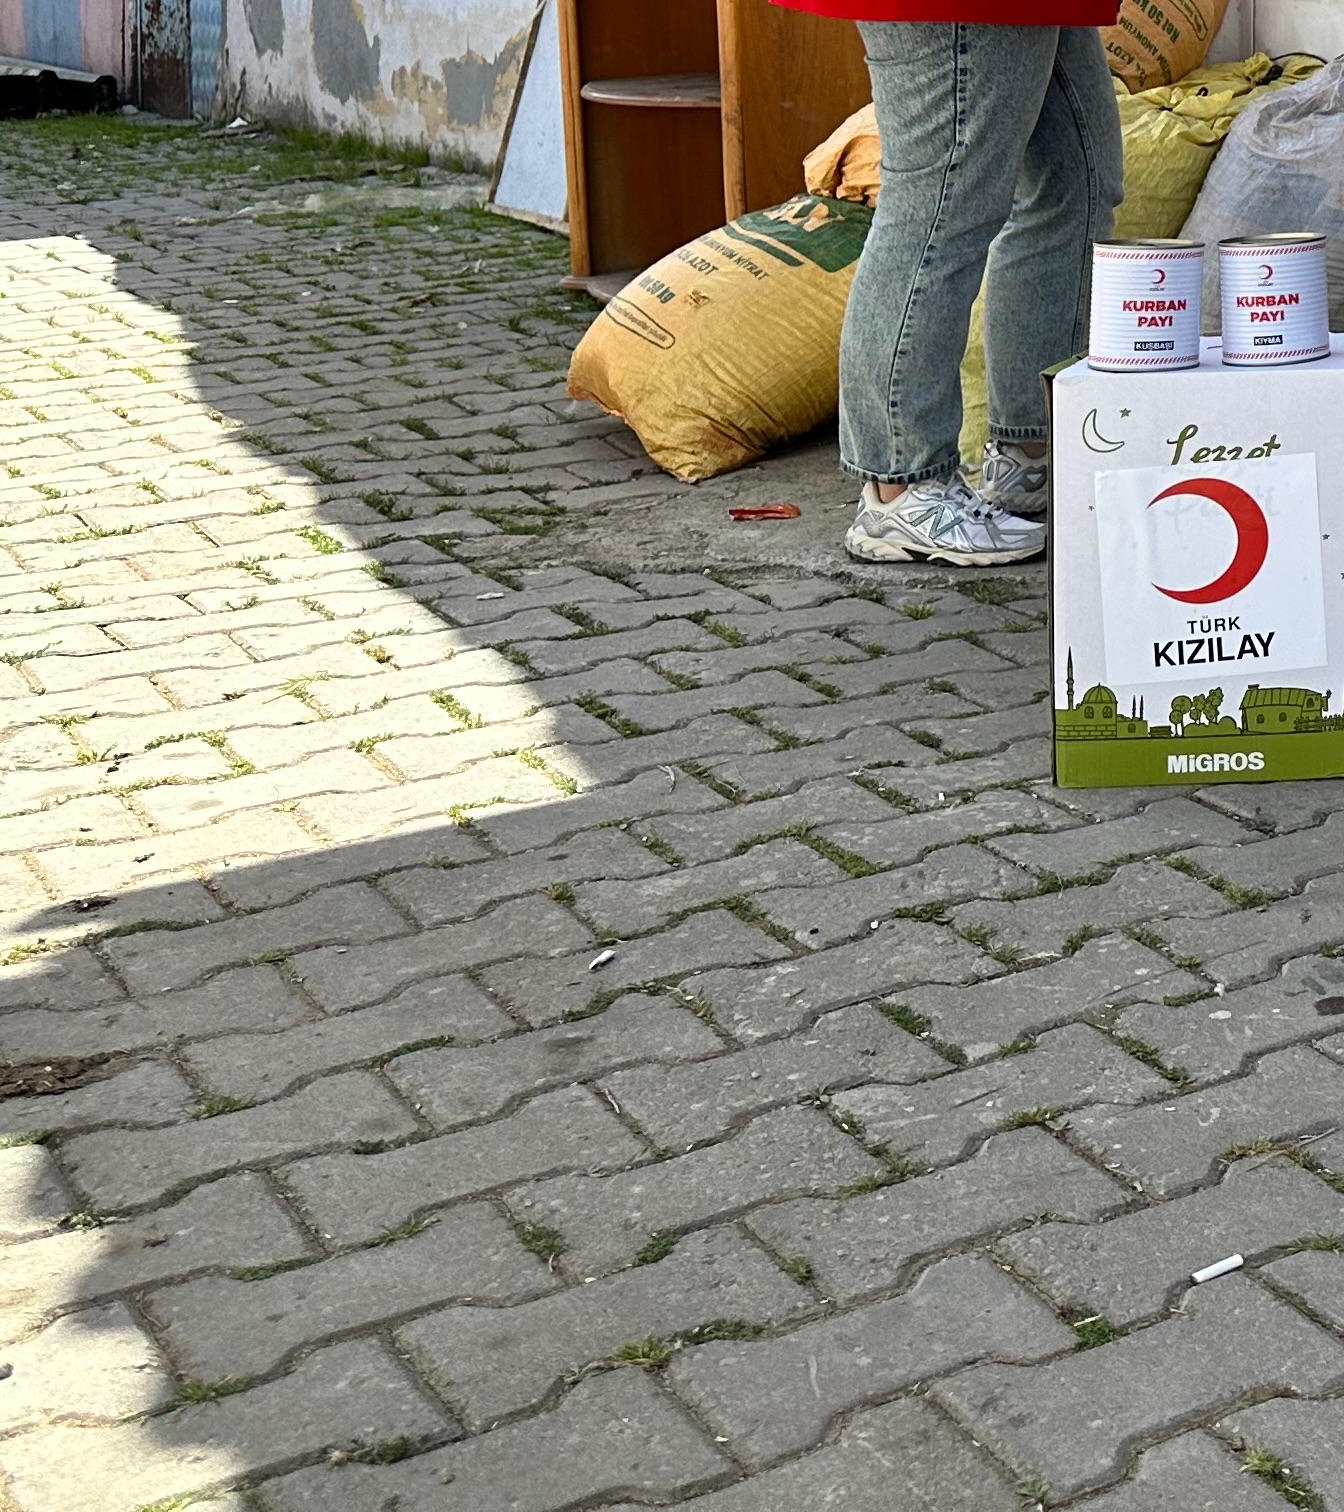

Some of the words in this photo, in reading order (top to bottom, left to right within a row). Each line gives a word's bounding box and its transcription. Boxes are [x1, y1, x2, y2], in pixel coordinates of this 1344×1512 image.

[1147, 5, 1164, 26] 50
[688, 256, 719, 275] AZOT
[1122, 299, 1187, 312] KURBAN
[1236, 292, 1300, 308] KURBAN
[1137, 314, 1174, 328] PAYI
[1249, 310, 1286, 324] PAYI
[1186, 615, 1241, 635] TÜRK
[1153, 631, 1275, 667] KIZILAY
